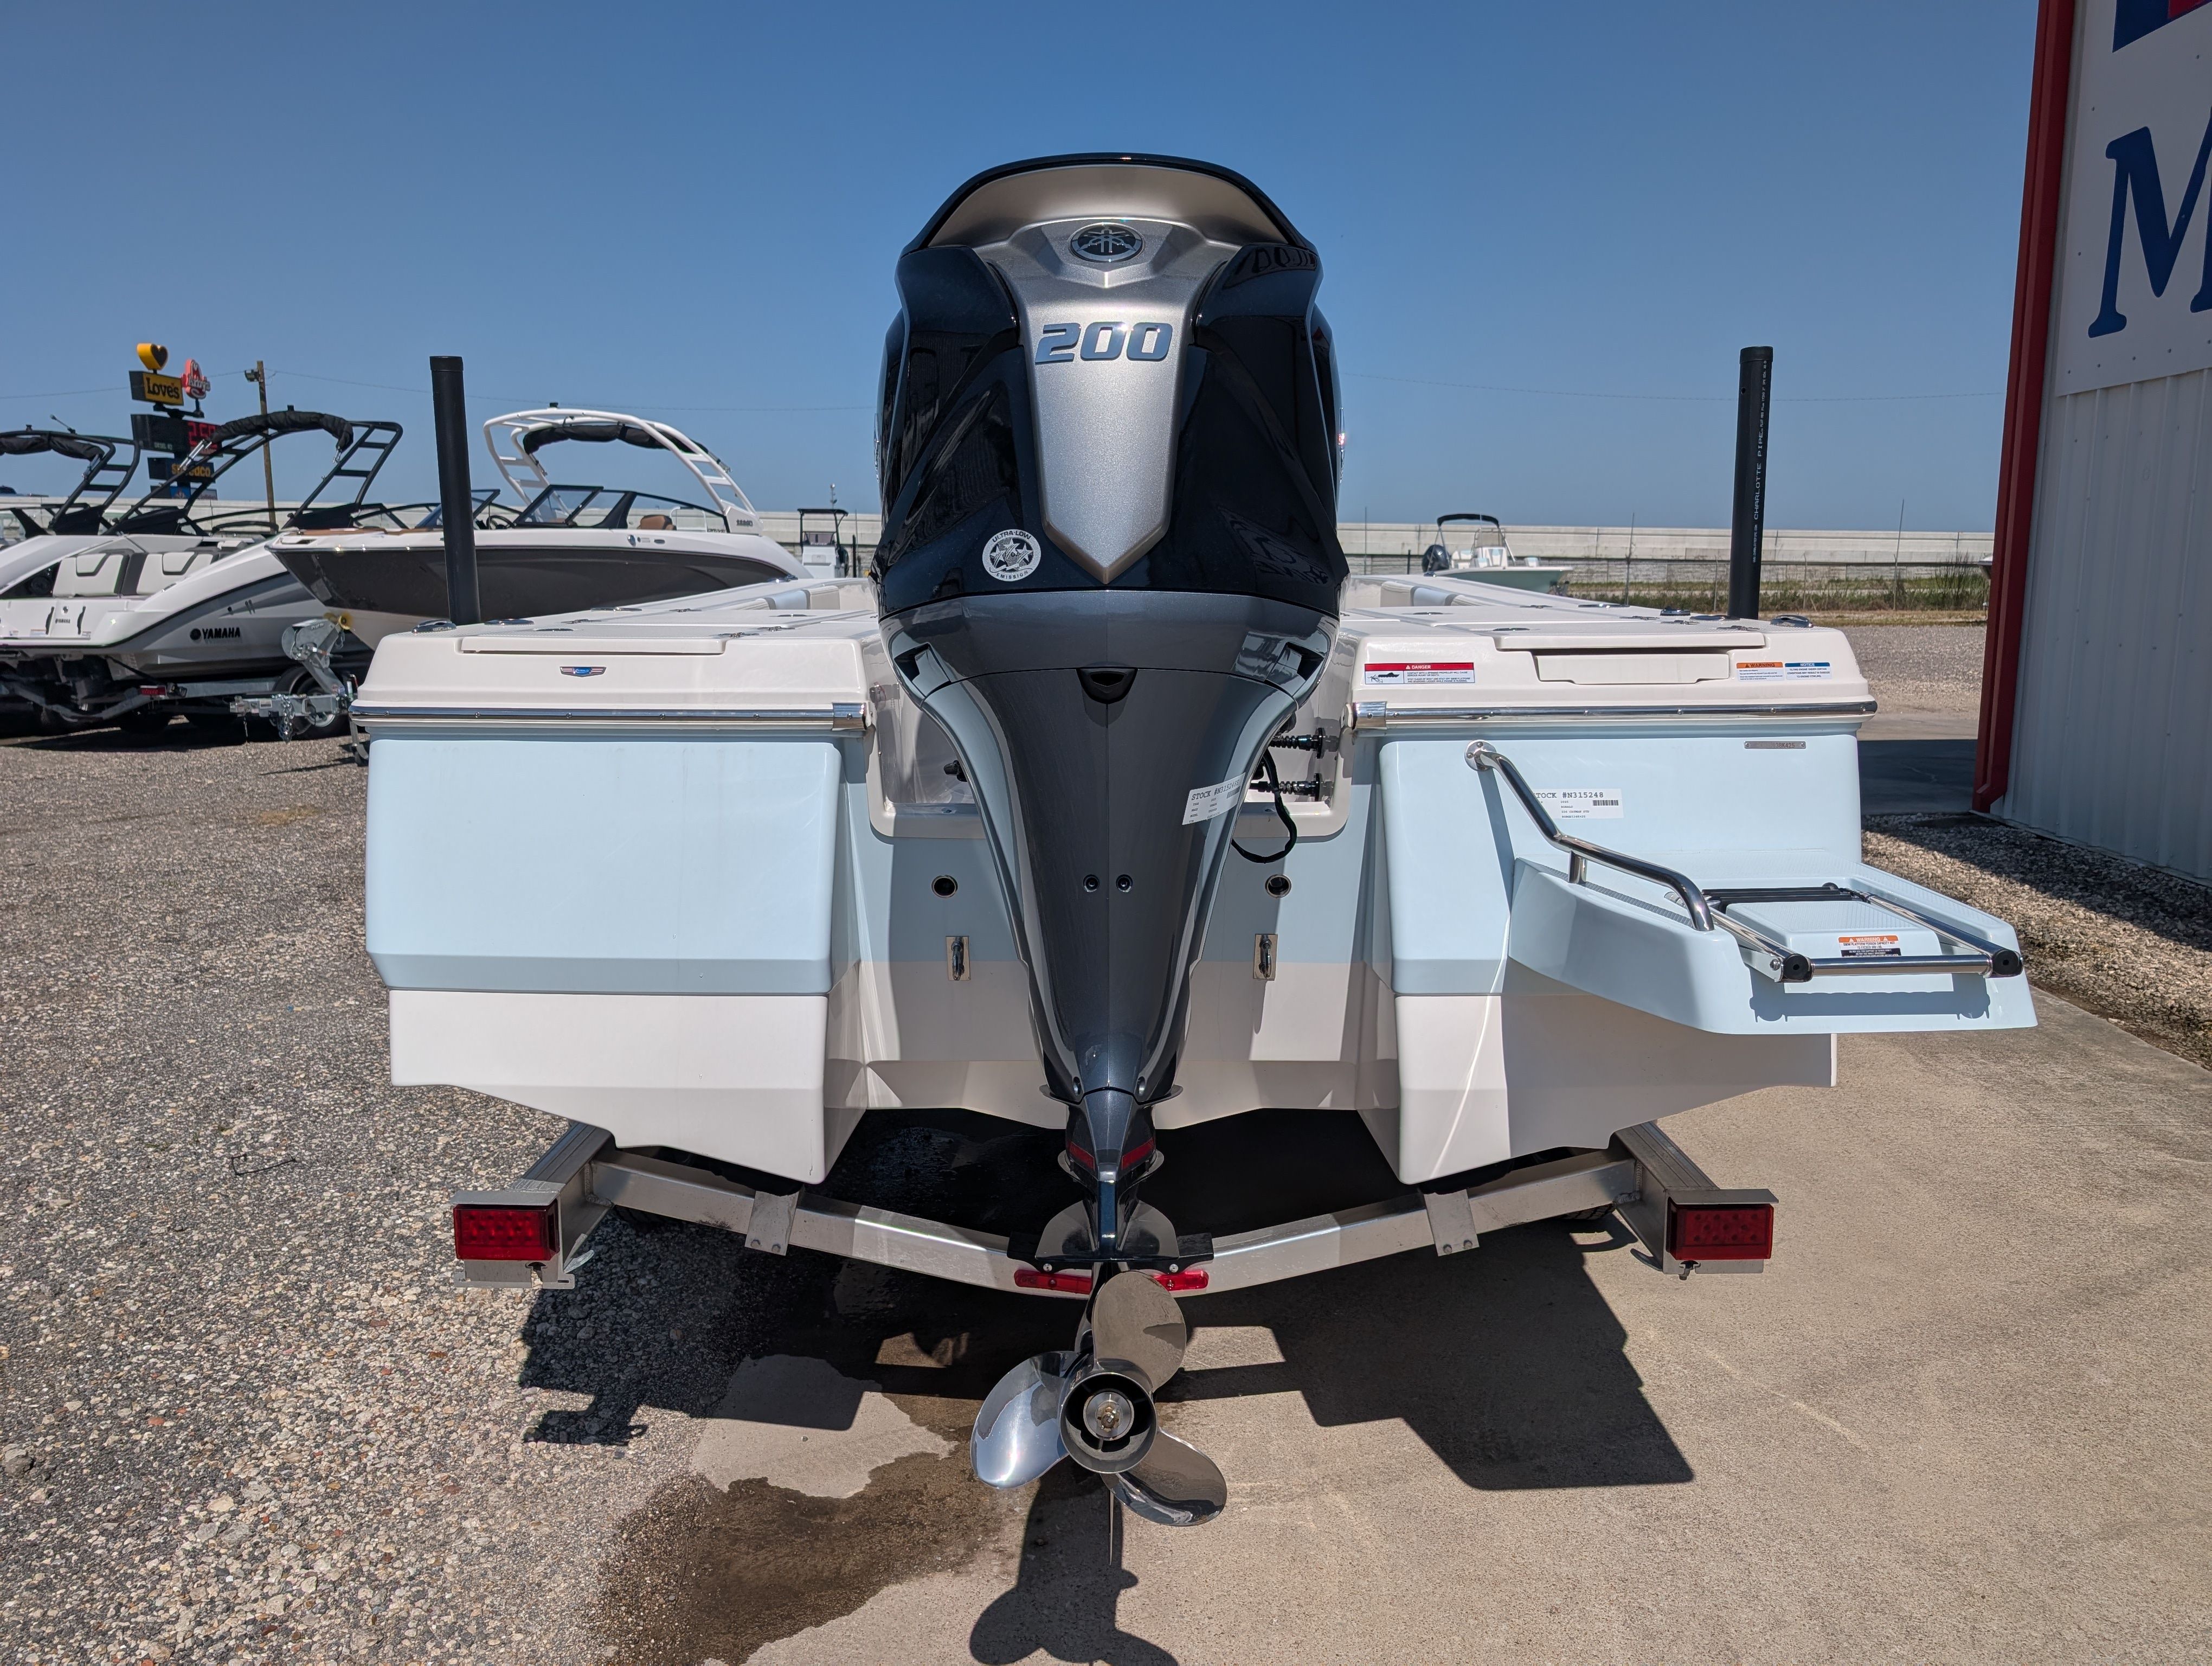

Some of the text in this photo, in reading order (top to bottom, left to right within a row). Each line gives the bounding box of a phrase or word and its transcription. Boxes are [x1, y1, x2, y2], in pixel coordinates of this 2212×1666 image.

[1035, 322, 1173, 365] 200
[146, 377, 180, 399] Love's
[1753, 463, 1762, 520] CHARLOTTE
[996, 571, 1028, 580] EMISSION
[202, 627, 240, 639] YAMAHA
[1191, 790, 1212, 800] STOCK
